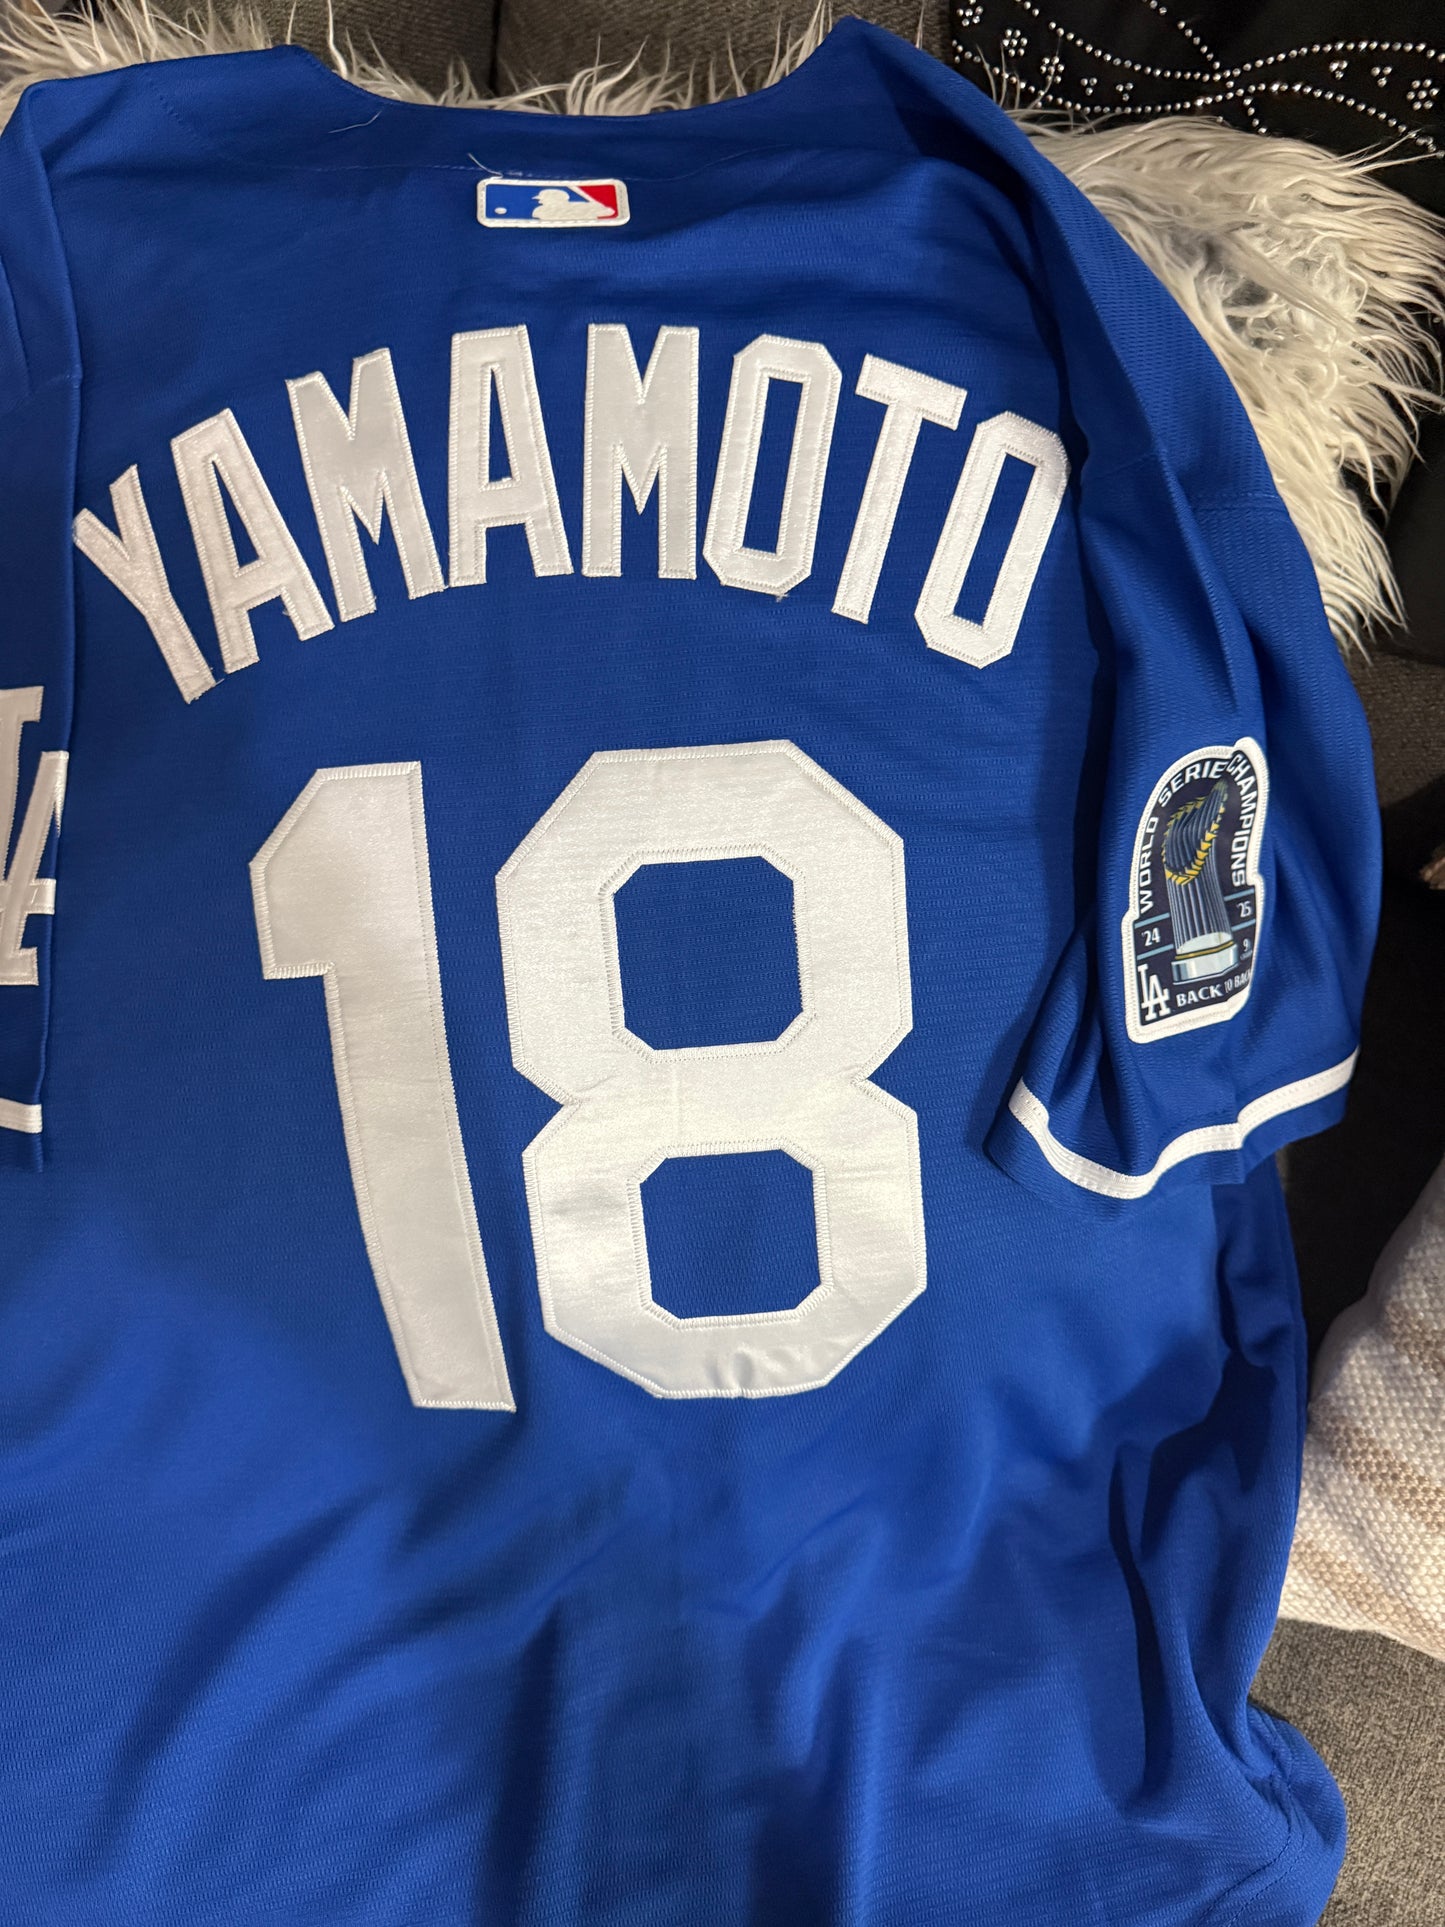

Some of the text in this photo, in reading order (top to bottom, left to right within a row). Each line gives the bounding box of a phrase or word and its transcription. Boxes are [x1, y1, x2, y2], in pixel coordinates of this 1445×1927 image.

[72, 324, 1068, 704] YAMAMOTO
[1139, 759, 1229, 914] WORLD SERIE
[1226, 753, 1258, 887] CHAMPIONS
[1137, 963, 1171, 1021] LA
[1176, 984, 1224, 1007] BACK
[249, 739, 927, 1412] 18
